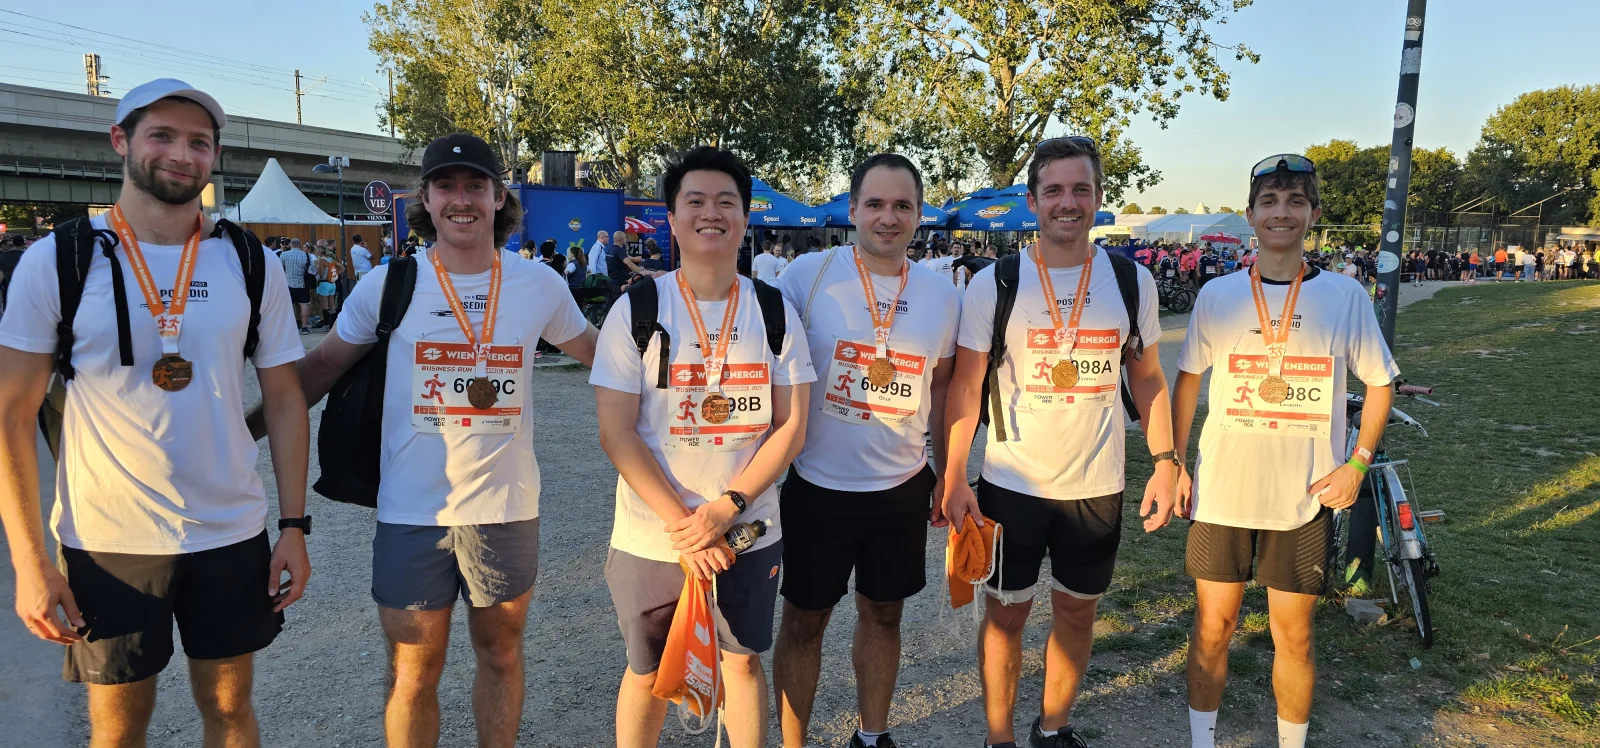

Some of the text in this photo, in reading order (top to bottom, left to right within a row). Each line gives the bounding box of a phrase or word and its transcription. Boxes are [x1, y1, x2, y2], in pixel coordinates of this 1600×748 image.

[370, 187, 374, 197] I
[370, 199, 386, 208] VIE
[160, 289, 208, 298] PODIO
[877, 301, 908, 312] POSDIO
[1080, 336, 1116, 344] ENERGIE
[446, 351, 519, 361] WIEN NERGIE
[860, 351, 876, 360] WIE
[1284, 362, 1326, 371] ENERGIE
[724, 371, 763, 379] ENERGIE
